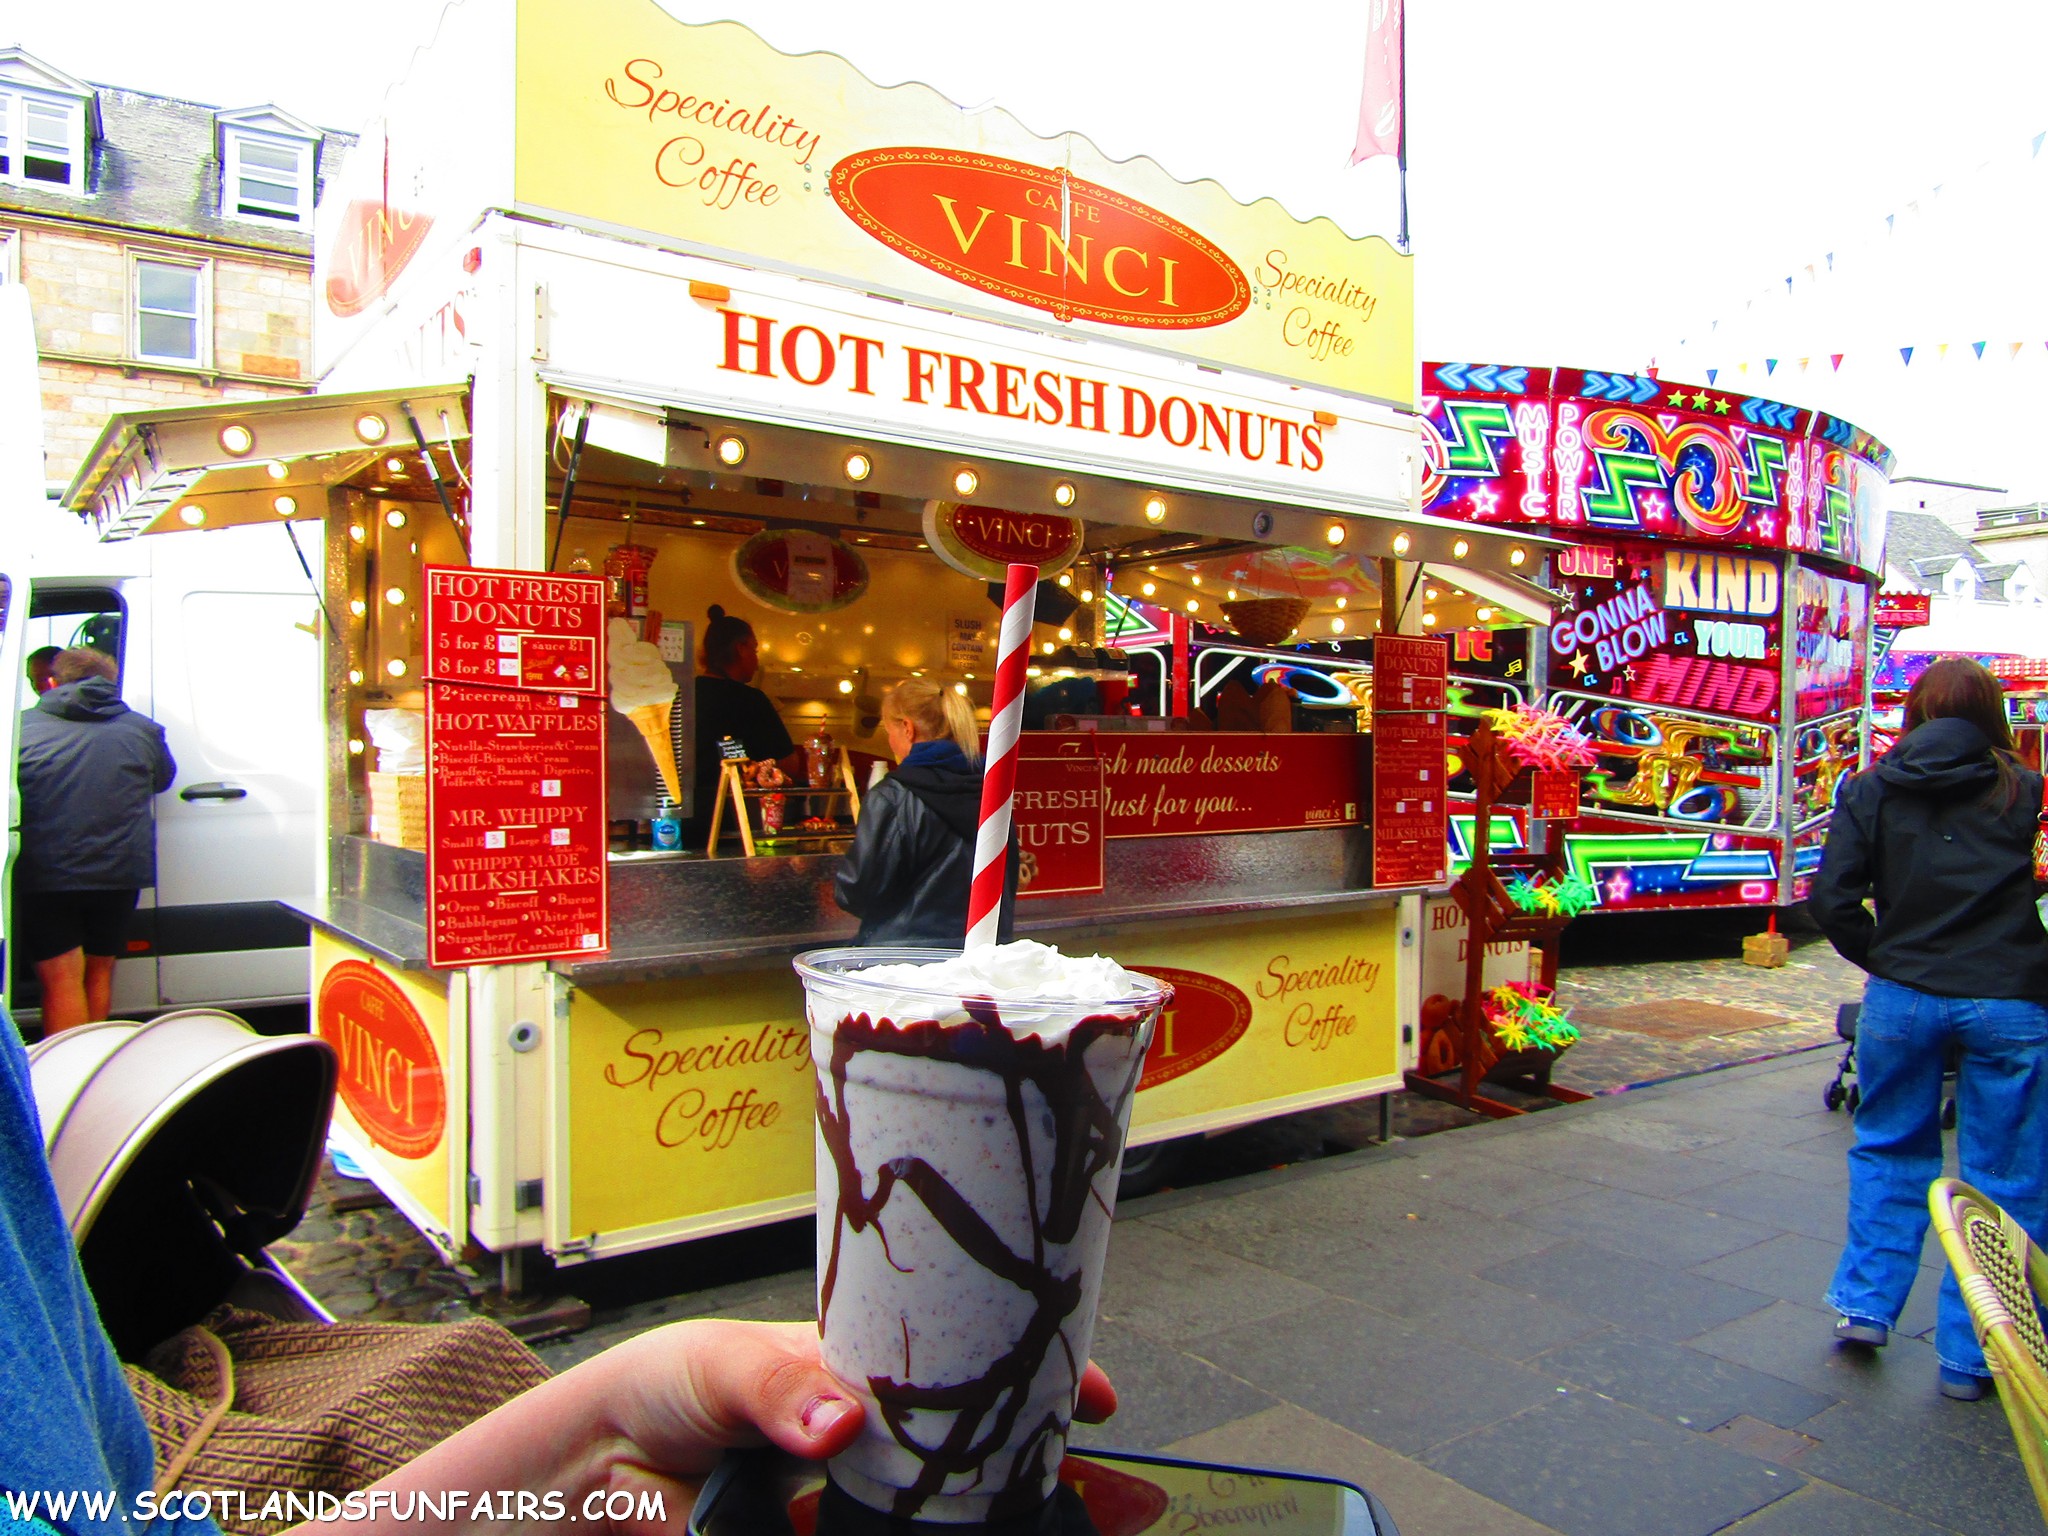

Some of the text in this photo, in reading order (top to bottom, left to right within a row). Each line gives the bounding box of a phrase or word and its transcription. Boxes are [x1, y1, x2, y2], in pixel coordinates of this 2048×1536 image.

[605, 59, 820, 165] Speciality
[655, 136, 781, 210] Coffee
[1026, 188, 1100, 223] CAFE
[932, 193, 1180, 307] VINCI
[1255, 249, 1377, 322] Speciality
[1283, 306, 1355, 360] Coffee
[715, 307, 1326, 473] HOT FRESH DONUTS
[1515, 402, 1549, 518] MUSIC
[1553, 402, 1585, 520] POWER
[1786, 442, 1804, 547] JUMPIN
[1806, 444, 1822, 550] PUMPIN
[978, 516, 1052, 549] VINCI
[432, 574, 599, 605] HOT FRESH
[1558, 545, 1614, 578] ONE
[1663, 550, 1779, 617] KIND
[450, 600, 582, 628] DONUTS
[954, 618, 982, 630] SLUSH
[1551, 583, 1656, 655] GONNA
[1876, 612, 1928, 622] BASS
[439, 633, 450, 648] 5
[456, 635, 479, 649] for
[532, 641, 565, 651] sauce
[569, 639, 585, 652] £1
[952, 642, 983, 653] CONTAIN
[1377, 640, 1444, 657] HOT FRESH
[1595, 610, 1667, 672] BLOW
[1694, 619, 1766, 660] YOUR
[439, 657, 450, 673] 8
[456, 659, 479, 674] for
[1384, 655, 1438, 673] DONUTS
[1630, 652, 1776, 714] MIND
[435, 713, 598, 731] HOT-WAFFLES
[1136, 745, 1197, 774] made
[1200, 745, 1282, 774] desserts
[448, 806, 588, 827] MR. WHIPPY
[1153, 784, 1189, 827] for
[1304, 800, 1341, 820] vinci's
[442, 837, 474, 849] Small
[510, 835, 540, 847] Large
[1376, 827, 1444, 840] MILKSHAKES
[452, 853, 580, 871] WHIPPY MADE
[437, 866, 600, 893] MILKSHAKES
[495, 896, 539, 910] Biscoff
[447, 915, 518, 930] Bubblegum
[528, 910, 569, 923] White
[445, 930, 517, 945] Strawberry
[471, 943, 513, 957] Salted
[517, 939, 570, 953] Caramel
[1457, 938, 1523, 962] DNUTS
[1256, 954, 1381, 1004] Speciality
[1283, 1001, 1357, 1052] Coffee
[338, 1011, 416, 1127] VINCI
[604, 1023, 812, 1092] Speciality
[655, 1086, 781, 1152] Coffee
